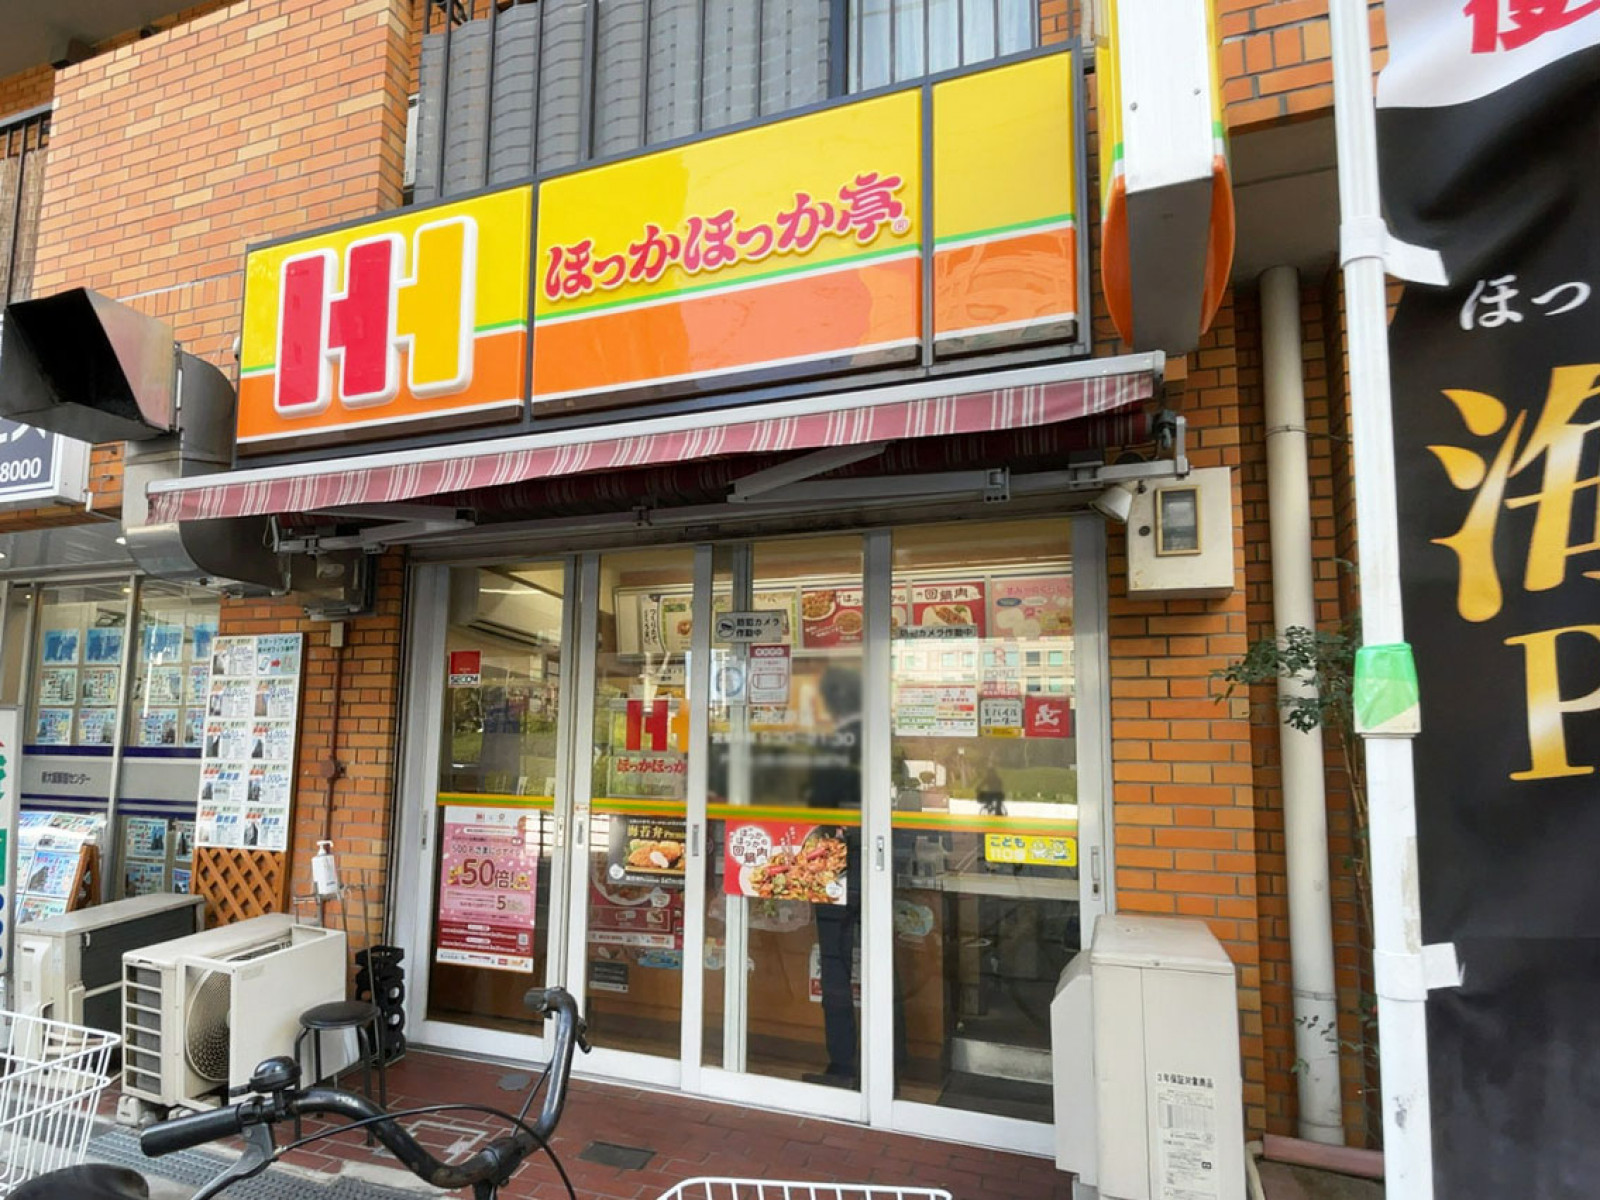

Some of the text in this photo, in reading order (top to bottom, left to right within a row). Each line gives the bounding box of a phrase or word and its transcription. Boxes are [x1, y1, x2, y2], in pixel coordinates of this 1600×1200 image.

[543, 172, 904, 298] ほっかほっか亭
[1458, 275, 1591, 331] ほっ
[0, 456, 42, 483] 8000
